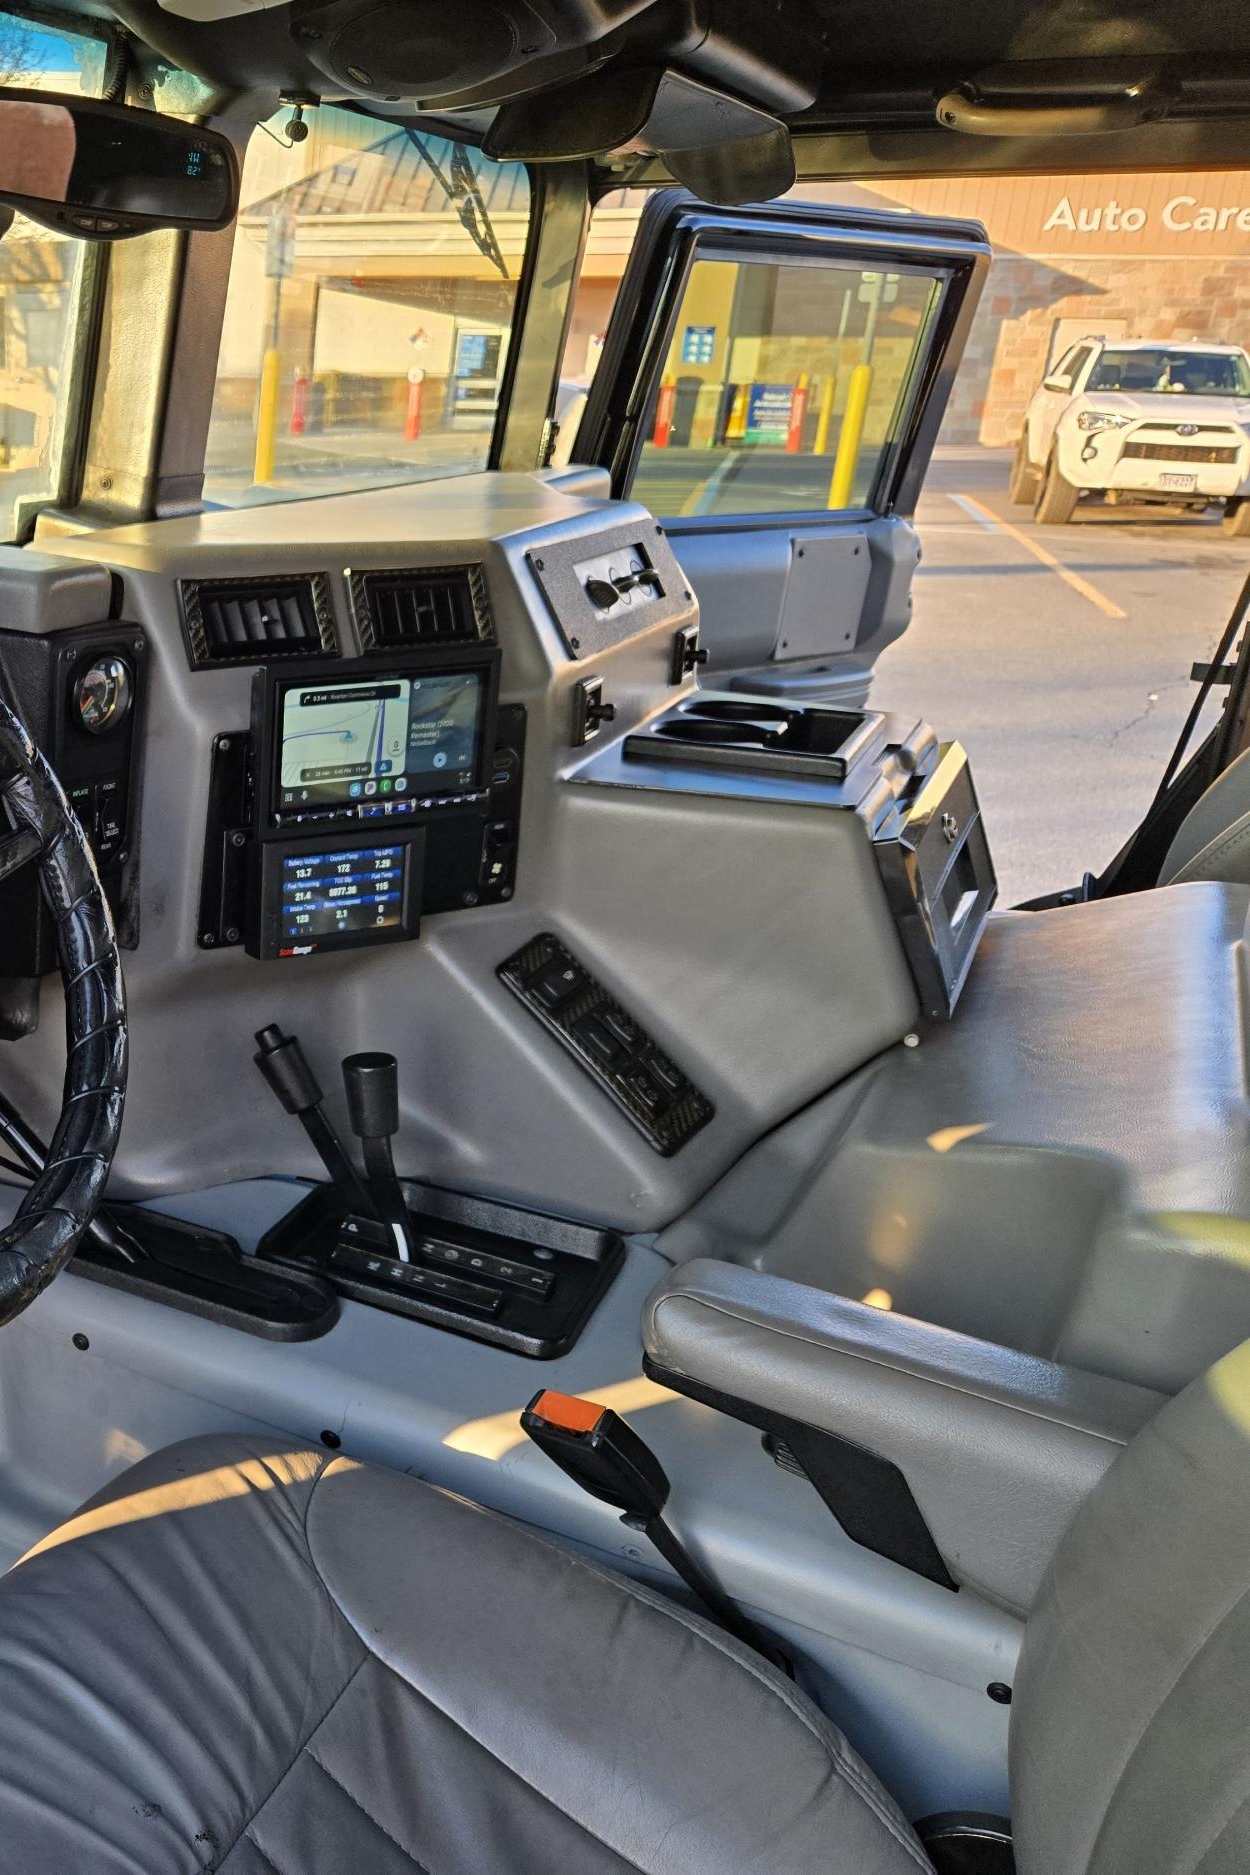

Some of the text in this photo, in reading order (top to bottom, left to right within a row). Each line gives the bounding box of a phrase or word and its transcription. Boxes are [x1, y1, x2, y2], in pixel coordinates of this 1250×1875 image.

[1042, 195, 1250, 233] Auto Care
[295, 868, 312, 879] 13.7
[348, 1223, 358, 1232] P
[500, 1266, 512, 1274] 2
[391, 1267, 403, 1277] H
